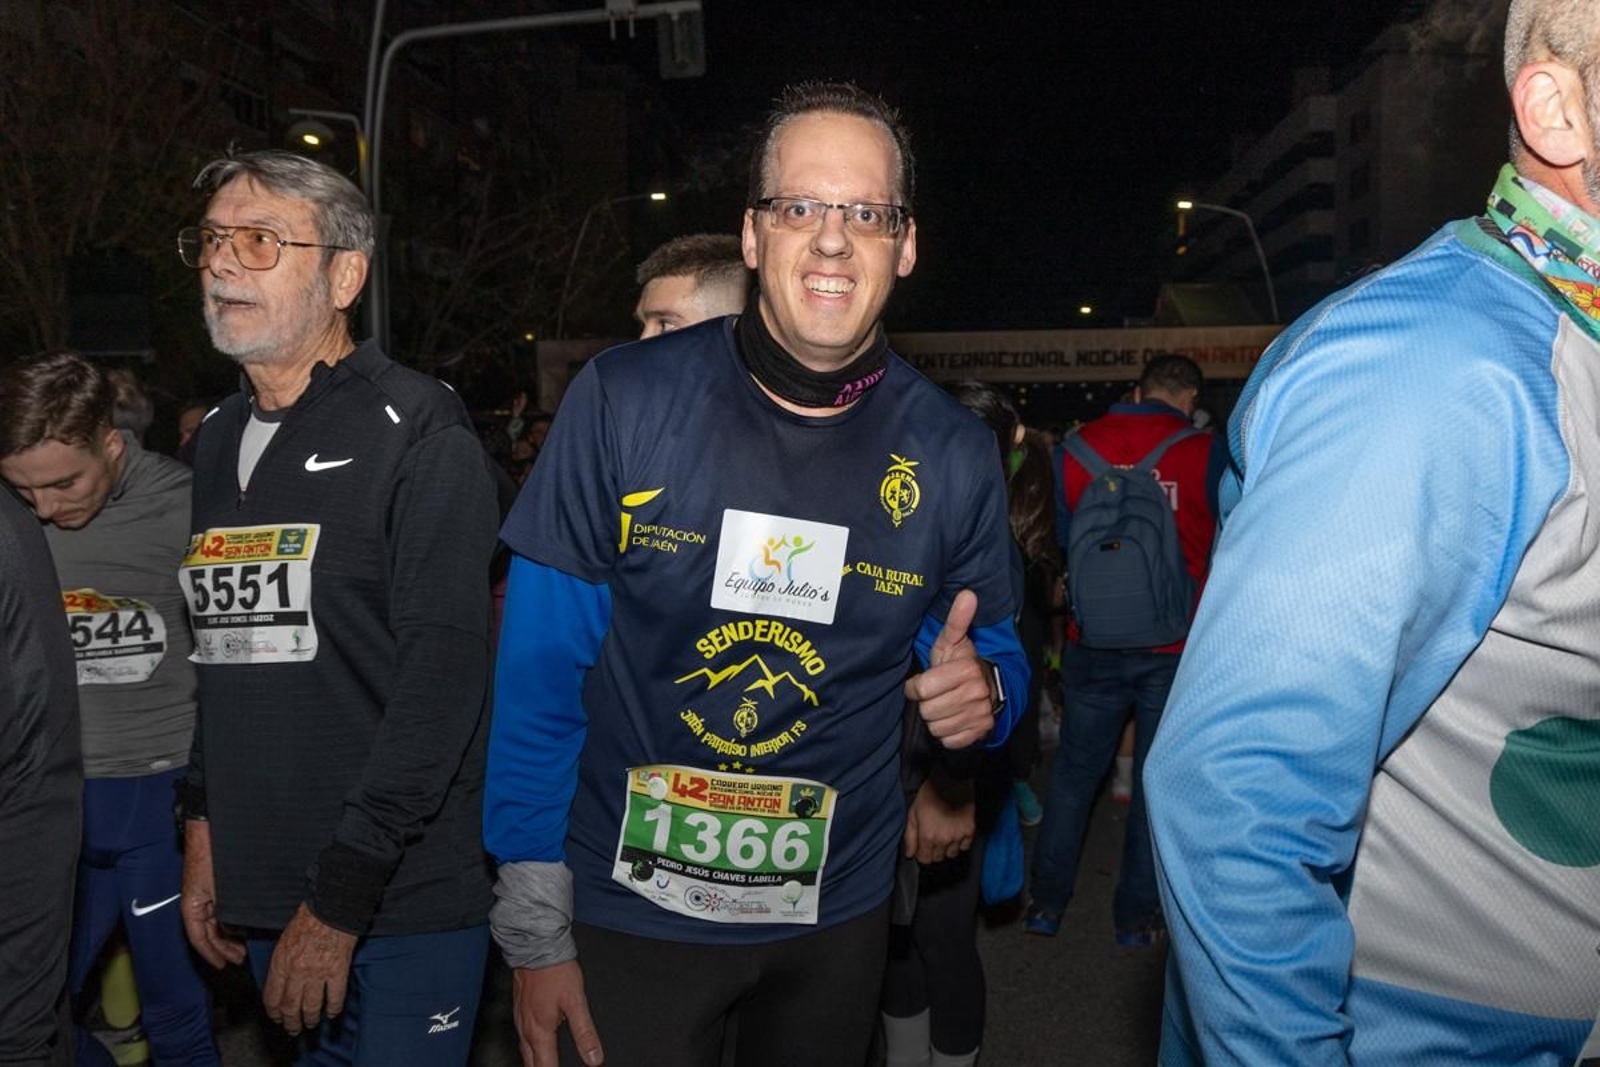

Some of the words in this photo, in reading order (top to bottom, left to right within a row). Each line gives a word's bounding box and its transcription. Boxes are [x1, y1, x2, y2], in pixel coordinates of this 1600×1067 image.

[1075, 349, 1139, 366] NOCHE
[200, 534, 225, 558] 42
[632, 536, 650, 546] DE
[633, 523, 706, 544] DIPUTACIÓN
[724, 571, 776, 596] Equipo
[856, 561, 883, 578] CAJA
[885, 569, 924, 587] RURAL
[189, 562, 291, 613] 5551
[70, 611, 154, 648] 544
[695, 619, 826, 676] SENDERISMO
[680, 709, 705, 736] JAÉN
[701, 732, 747, 757] PARAÍSO
[750, 731, 796, 758] INTERIOR
[790, 720, 808, 737] FS
[671, 773, 709, 803] 42
[709, 792, 735, 806] SAN
[738, 795, 782, 810] ANTON
[644, 803, 811, 871] 1366
[656, 857, 684, 872] PEDRO
[684, 866, 711, 878] JESÚS
[712, 871, 747, 883] CHAVES
[748, 875, 783, 884] LABELLA
